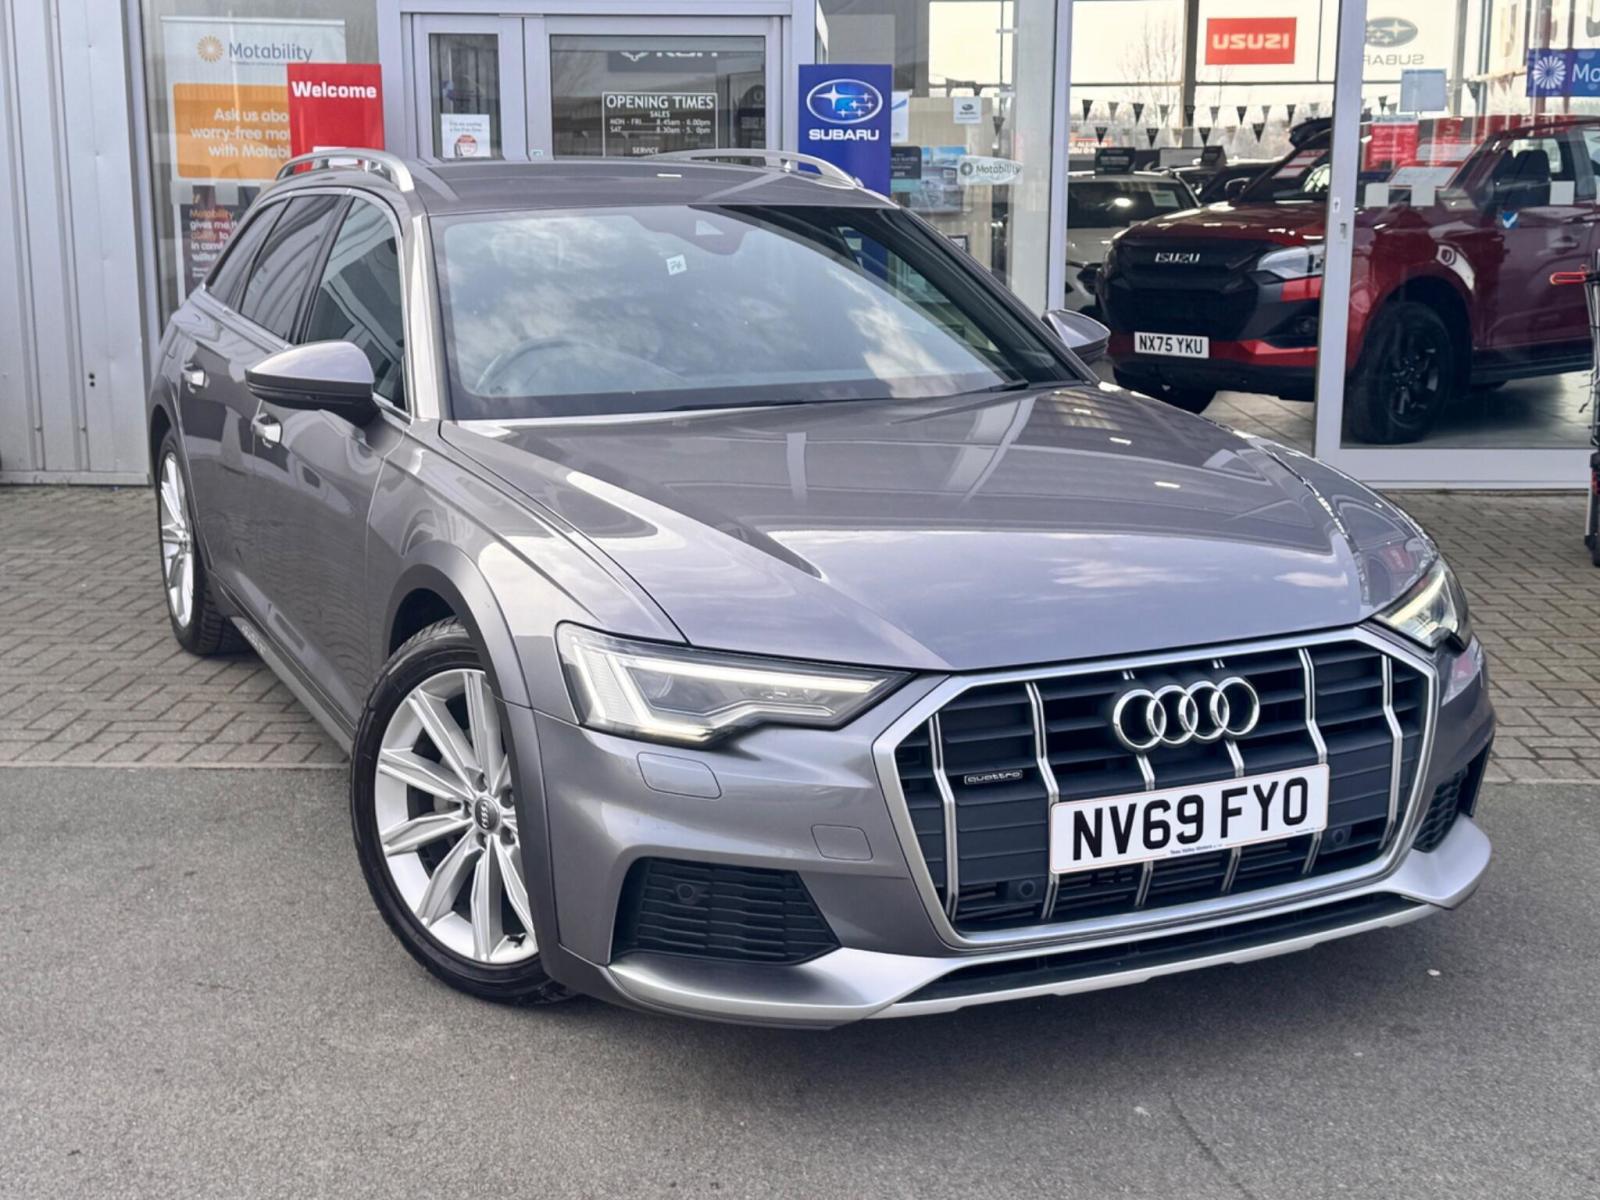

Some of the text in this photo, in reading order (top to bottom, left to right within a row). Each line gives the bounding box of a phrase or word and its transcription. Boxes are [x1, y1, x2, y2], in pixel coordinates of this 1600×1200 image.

[229, 42, 313, 63] Motability
[291, 80, 377, 98] Welcome
[606, 95, 715, 109] OPENING TIMES
[214, 108, 240, 121] Ask
[243, 111, 258, 121] us
[190, 126, 262, 141] worry-free
[809, 129, 880, 141] SUBARU
[208, 144, 238, 157] with
[976, 164, 1021, 175] Motability
[1155, 252, 1200, 263] ISUZU
[1139, 335, 1203, 355] NX75 YKU
[967, 771, 1020, 783] quattro
[1072, 776, 1308, 861] NV69 FYO
